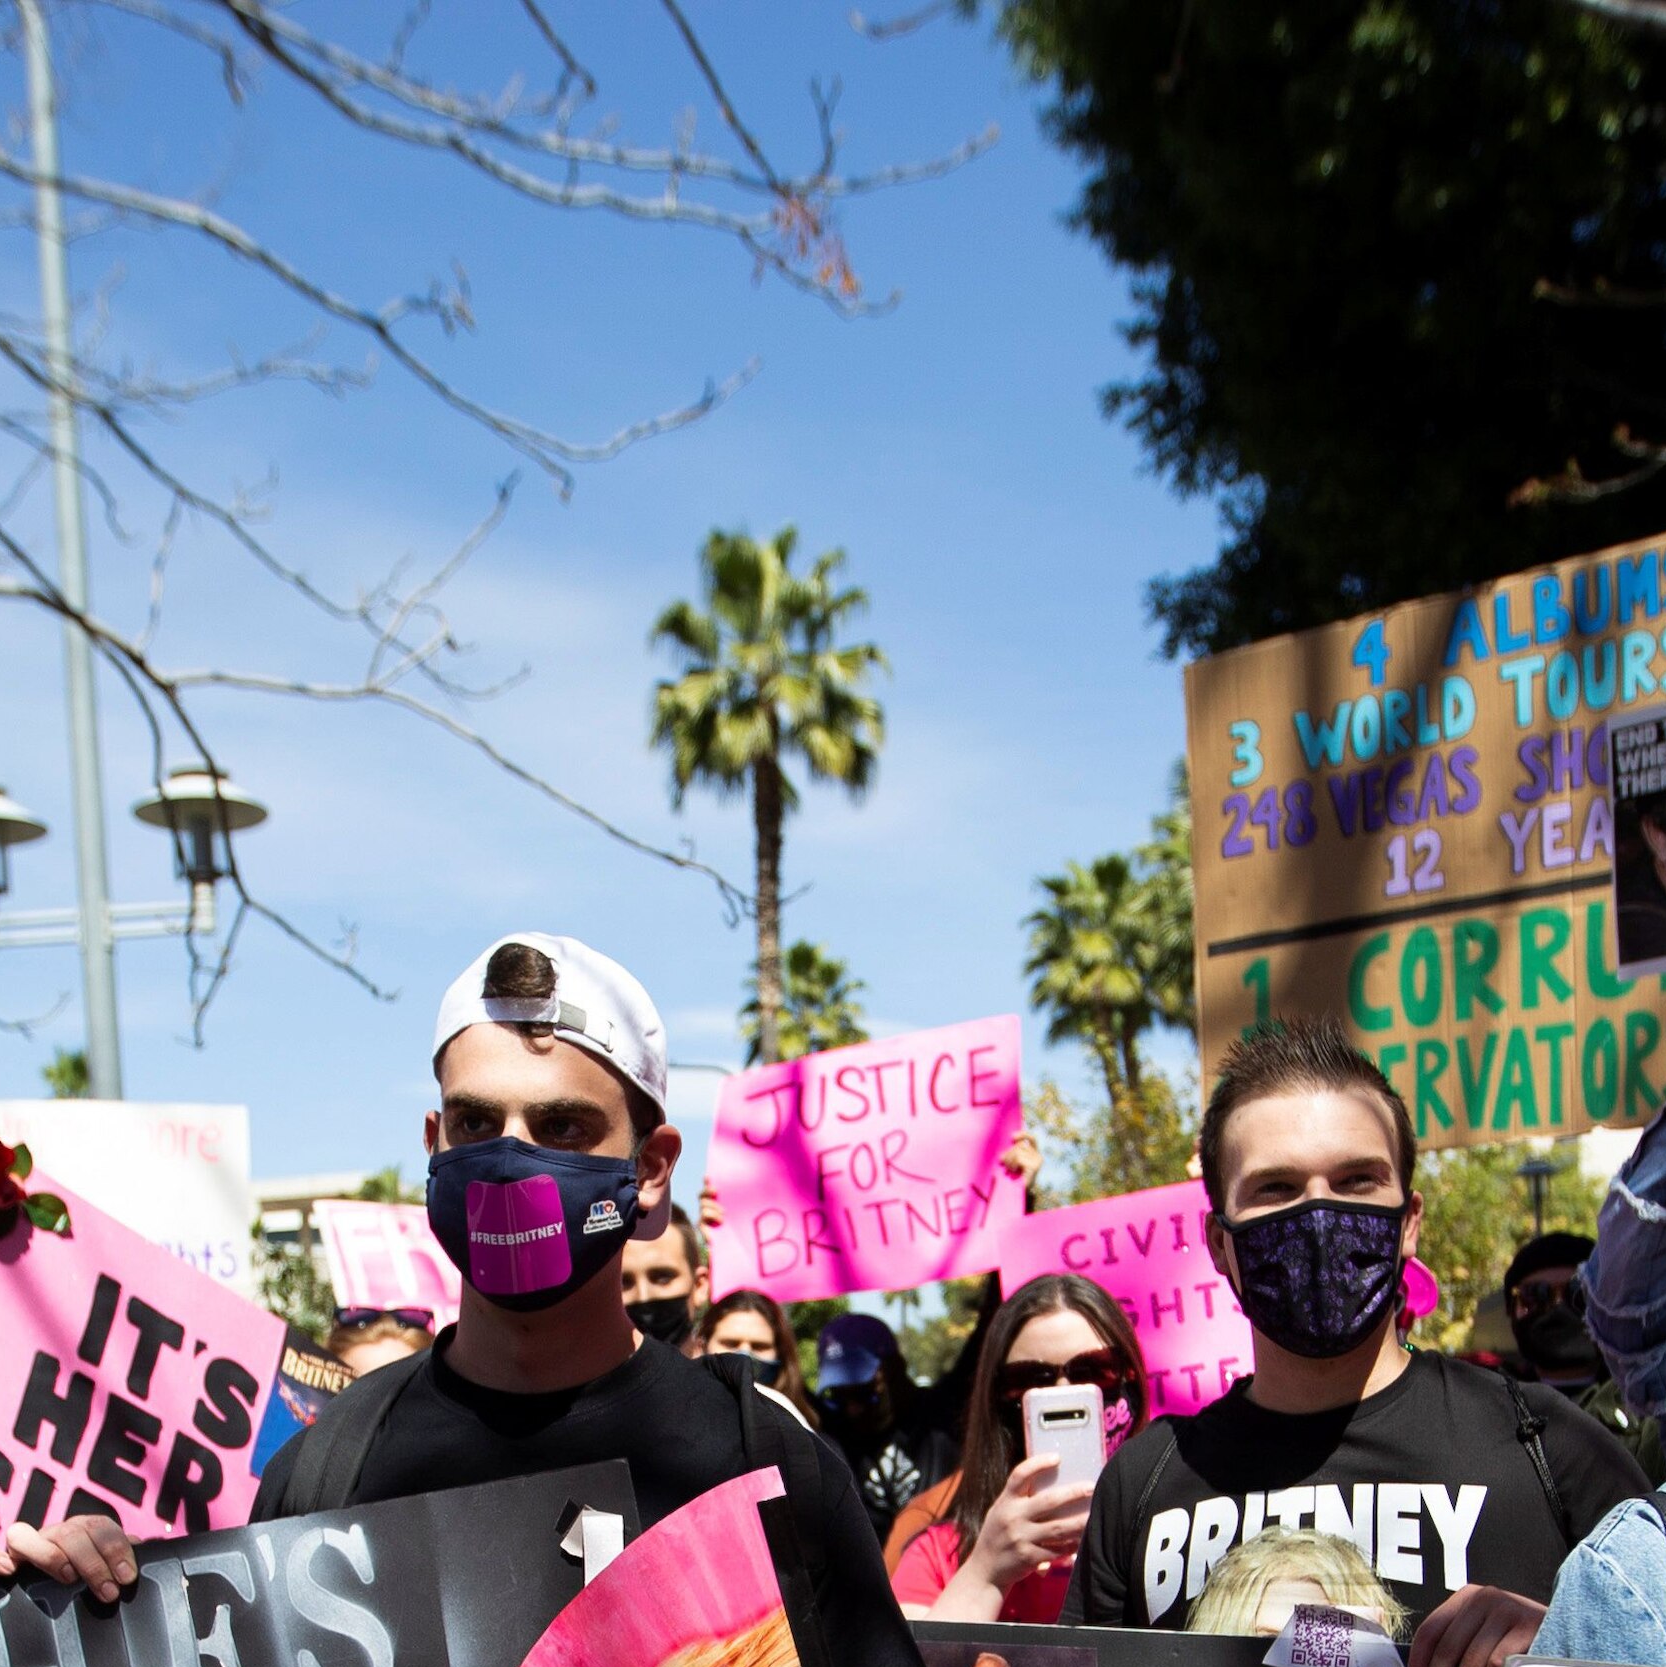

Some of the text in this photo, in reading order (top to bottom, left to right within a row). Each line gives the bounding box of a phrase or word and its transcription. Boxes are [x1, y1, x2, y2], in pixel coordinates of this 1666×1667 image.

[1352, 619, 1391, 686] 4
[1228, 720, 1265, 787] 3
[1293, 673, 1477, 771] WORLD
[1616, 723, 1660, 750] END
[1219, 781, 1318, 859] 248
[1326, 745, 1482, 838] VEGAS
[1383, 827, 1446, 897] 12
[1239, 957, 1288, 1043] 1
[742, 1043, 1002, 1149] JUSTICE
[815, 1129, 934, 1201] FOR
[470, 1221, 563, 1246] #FREEBRITNEY
[753, 1176, 997, 1279] BRITNEY
[1061, 1210, 1207, 1270] CIVI
[77, 1273, 259, 1450] IT'S
[13, 1350, 224, 1533] HER
[1144, 1483, 1487, 1624] BRITNEY
